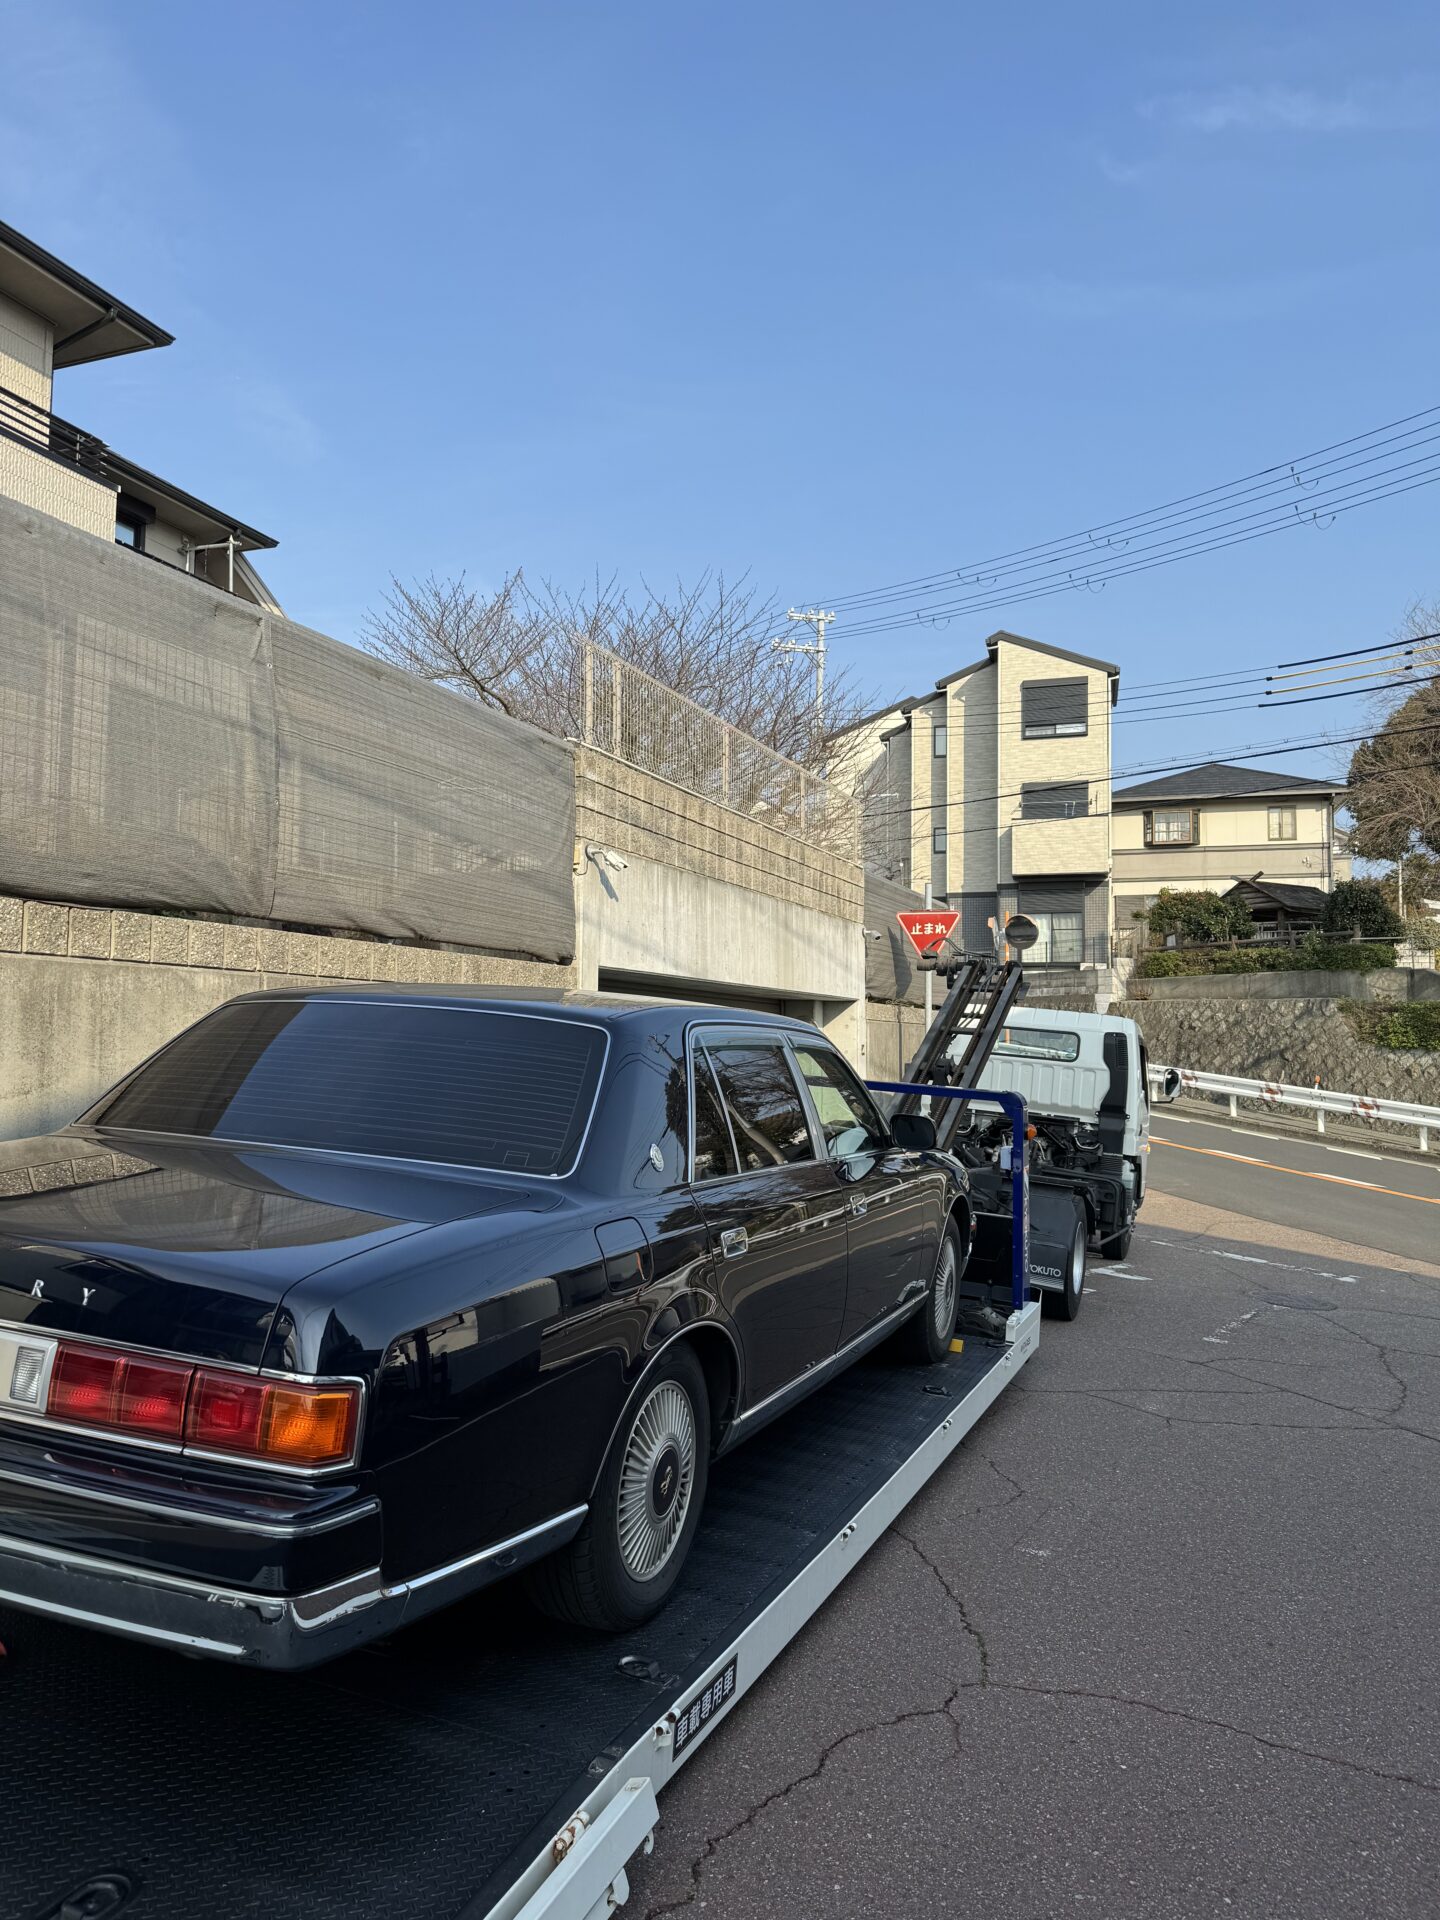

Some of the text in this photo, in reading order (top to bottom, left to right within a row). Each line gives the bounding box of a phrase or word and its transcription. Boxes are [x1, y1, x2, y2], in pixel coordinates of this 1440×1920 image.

[911, 922, 947, 935] 止まれ
[1029, 1264, 1061, 1277] OKUTO
[676, 1665, 734, 1748] 車載専用車
